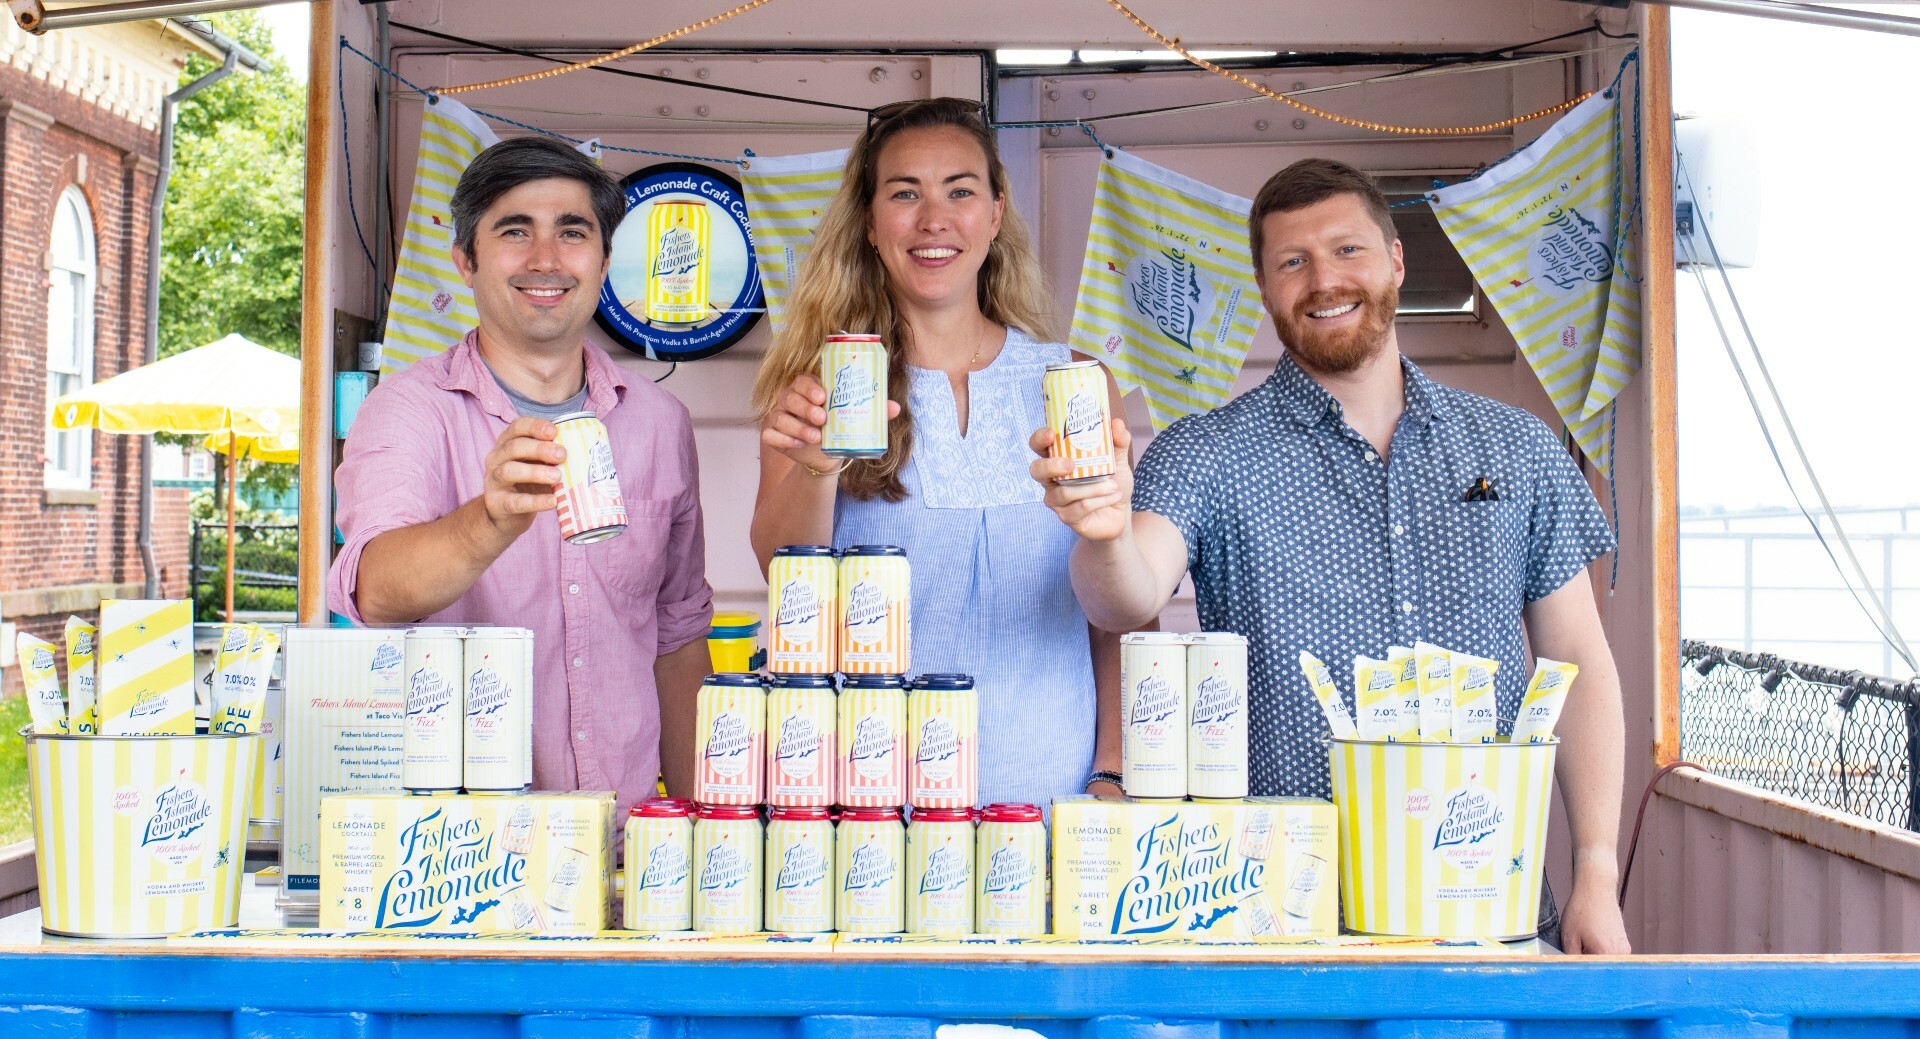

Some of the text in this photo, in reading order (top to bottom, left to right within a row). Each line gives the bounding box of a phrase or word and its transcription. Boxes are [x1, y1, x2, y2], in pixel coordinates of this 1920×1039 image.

[635, 177, 697, 198] Lemonade
[701, 181, 730, 205] Craft
[1561, 183, 1568, 191] N
[661, 228, 690, 250] Fishers
[667, 238, 695, 258] Island
[652, 243, 704, 278] Lemonade
[1541, 233, 1583, 271] Island
[1537, 247, 1585, 290] Fishers
[1131, 263, 1155, 319] Fishers
[1151, 259, 1169, 313] Island
[608, 306, 620, 321] Made
[621, 320, 632, 331] with
[633, 328, 659, 343] Premium
[690, 325, 725, 344] Barrel-Aged
[724, 307, 747, 328] Whiskey
[411, 668, 439, 691] Fishers
[416, 680, 443, 697] Island
[471, 668, 497, 691] Fishers
[475, 681, 501, 698] Island
[1137, 676, 1165, 698] Fishers
[1198, 676, 1228, 699] Fishers
[311, 698, 339, 709] Fishers
[342, 698, 367, 708] Island
[405, 682, 453, 718] Lemonade
[466, 682, 512, 718] Lemonade
[1143, 687, 1170, 705] Island
[1204, 687, 1231, 706] Island
[1404, 700, 1419, 708] 7.0
[1130, 691, 1180, 726] Lemonade
[1192, 691, 1241, 726] Lemonade
[1373, 708, 1397, 717] 7.0%
[1468, 709, 1493, 718] 7.0%
[1529, 707, 1550, 716] 7.0%
[416, 716, 436, 727] Fizz
[475, 717, 494, 728] Fizz
[1144, 724, 1164, 735] Fizz
[1205, 725, 1225, 735] Fizz
[380, 759, 399, 767] Spiked
[114, 800, 140, 810] Spiked
[115, 792, 138, 800] 100%
[156, 785, 194, 813] Fishers
[1447, 789, 1484, 816] Fishers
[165, 795, 198, 820] Island
[1406, 803, 1430, 812] Spiked
[1456, 801, 1489, 823] Island
[400, 806, 482, 865] Fishers
[1137, 812, 1219, 870] Fishers
[419, 831, 494, 884] Island
[649, 842, 680, 865] Fishers
[657, 853, 684, 871] Island
[707, 845, 737, 866] Fishers
[713, 855, 740, 872] Island
[785, 843, 815, 865] Fishers
[791, 855, 819, 871] Island
[929, 846, 959, 868] Fishers
[992, 847, 1021, 868] Fishers
[1156, 838, 1231, 890] Island
[639, 854, 691, 892] Lemonade
[699, 856, 752, 893] Lemonade
[775, 856, 829, 892] Lemonade
[919, 859, 972, 896] Lemonade
[935, 858, 963, 875] Island
[983, 859, 1036, 895] Lemonade
[998, 858, 1025, 875] Island
[375, 853, 526, 928] Lemonade
[1111, 859, 1264, 934] Lemonade
[354, 898, 362, 908] 8
[1090, 904, 1097, 914] 8
